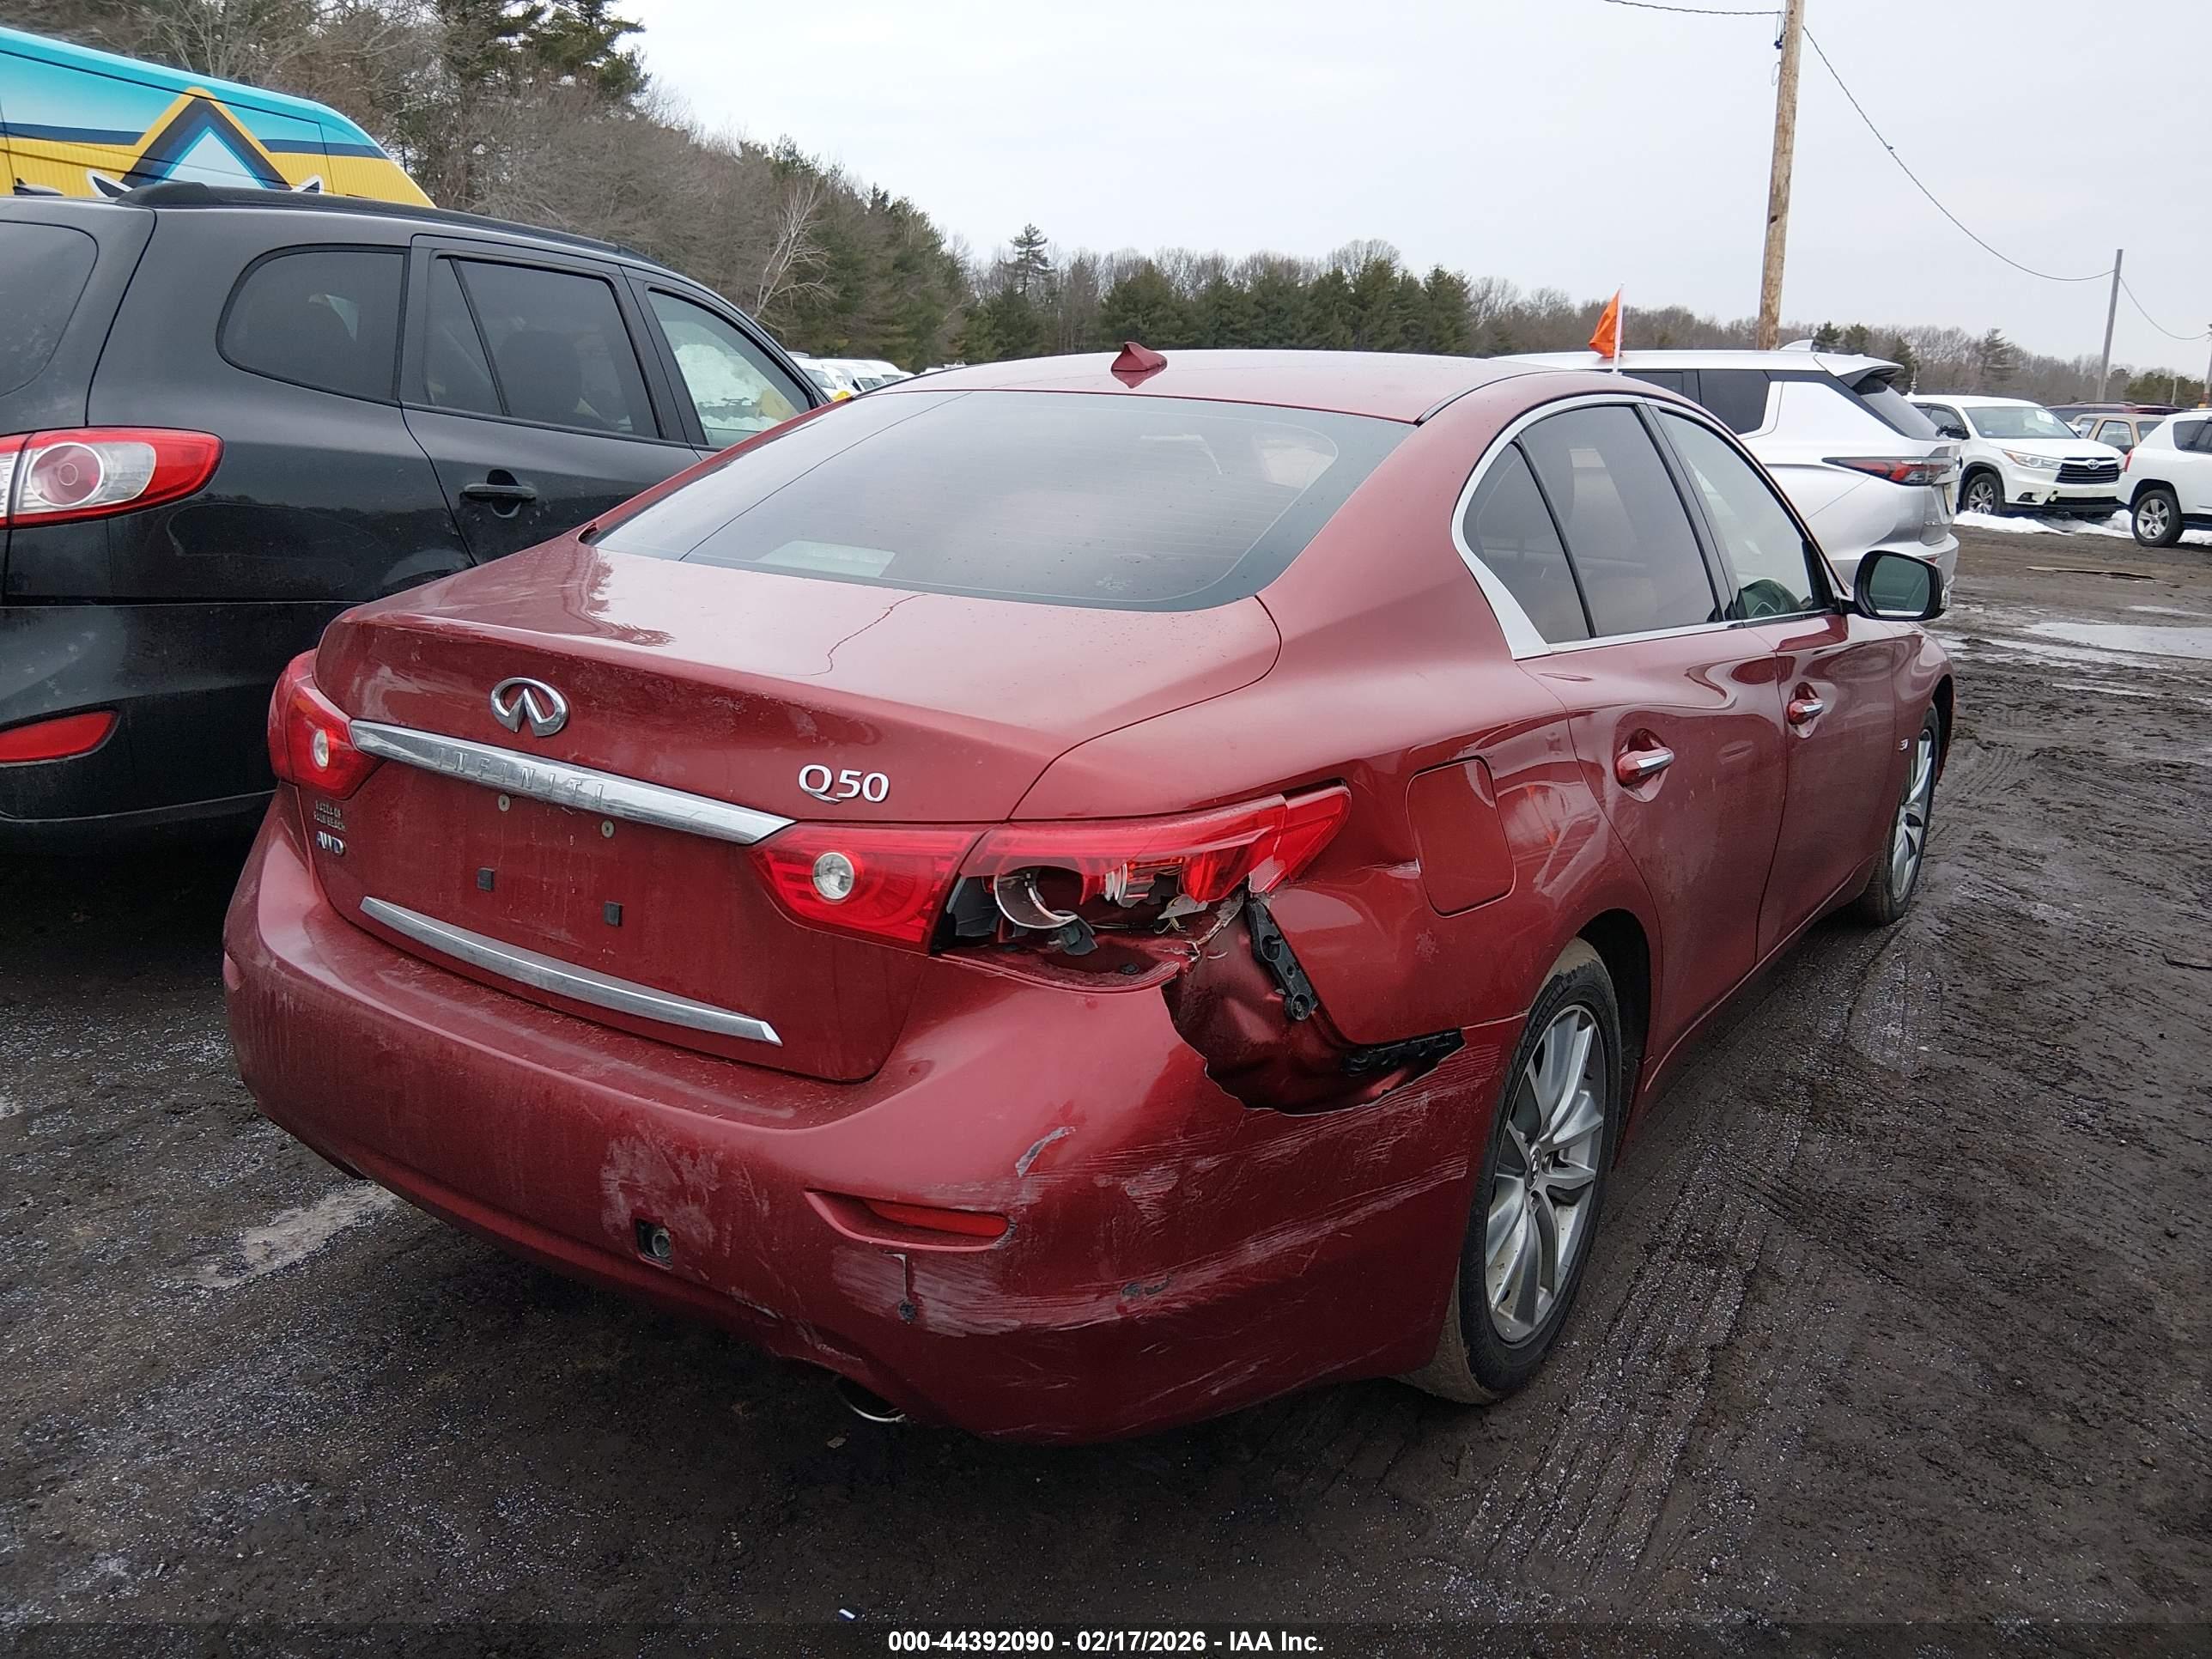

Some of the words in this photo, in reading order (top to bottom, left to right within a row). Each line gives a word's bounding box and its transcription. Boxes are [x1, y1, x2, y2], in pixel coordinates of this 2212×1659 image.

[438, 747, 605, 805] INFINITI
[798, 763, 890, 805] Q50
[316, 830, 344, 855] AWD
